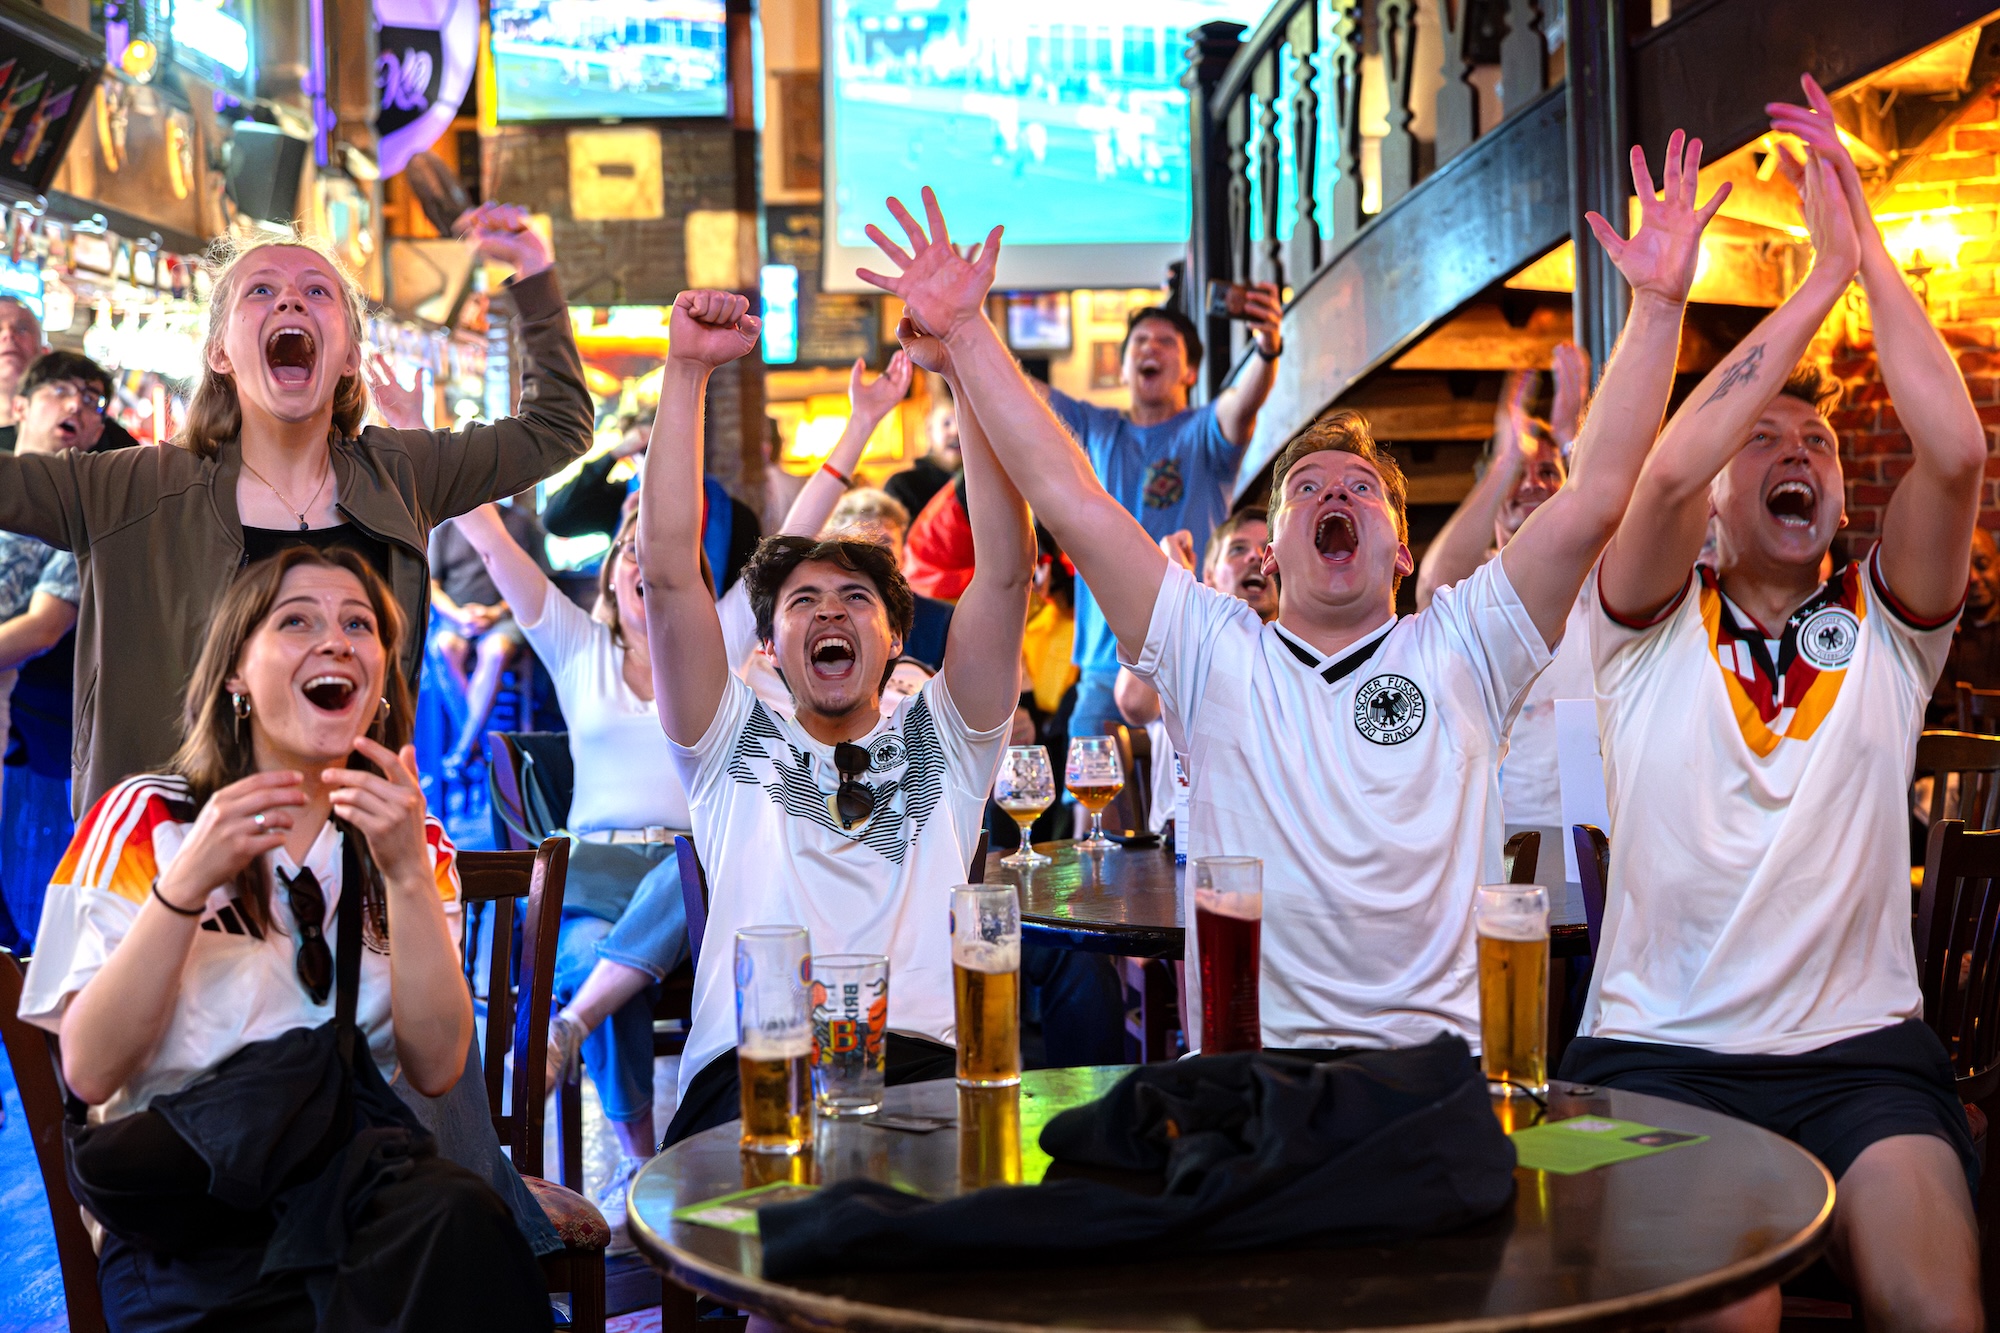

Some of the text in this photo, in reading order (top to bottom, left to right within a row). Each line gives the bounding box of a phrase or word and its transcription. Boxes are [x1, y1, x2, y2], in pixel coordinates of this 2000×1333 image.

[1355, 677, 1422, 738] DEUTSCHER FUSSBALL
[1382, 725, 1414, 743] BUND
